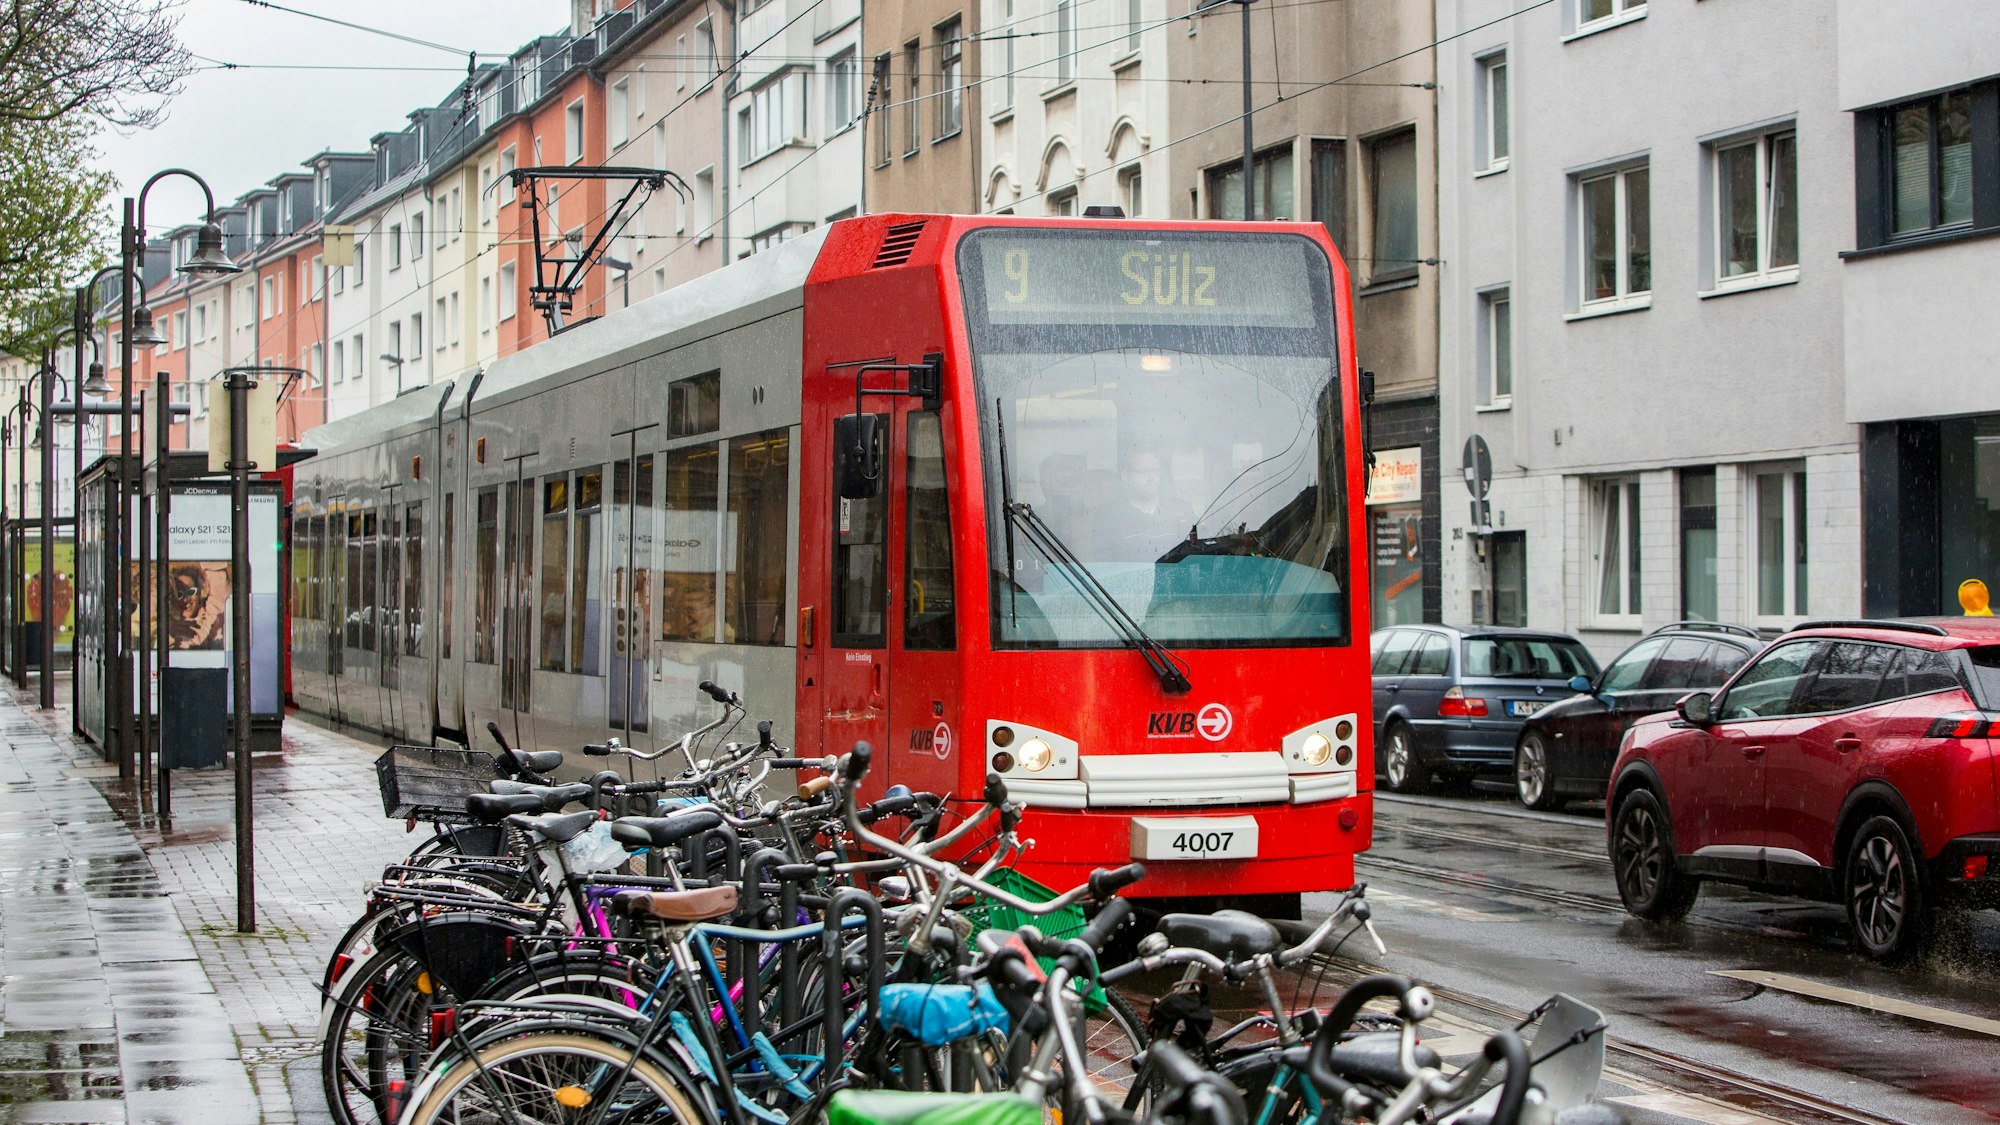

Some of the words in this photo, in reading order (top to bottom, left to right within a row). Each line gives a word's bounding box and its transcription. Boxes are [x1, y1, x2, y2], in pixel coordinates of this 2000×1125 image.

[1005, 249, 1029, 303] 9
[1120, 250, 1216, 305] Sülz
[1381, 463, 1395, 480] City
[1396, 460, 1418, 479] Repair
[169, 525, 195, 535] alaxy
[197, 525, 211, 533] S21
[217, 525, 232, 533] S21
[845, 652, 855, 661] Kein
[855, 652, 872, 663] Einstieg
[1148, 712, 1196, 734] KVB
[910, 729, 934, 750] KVB
[1172, 832, 1234, 852] 4007
